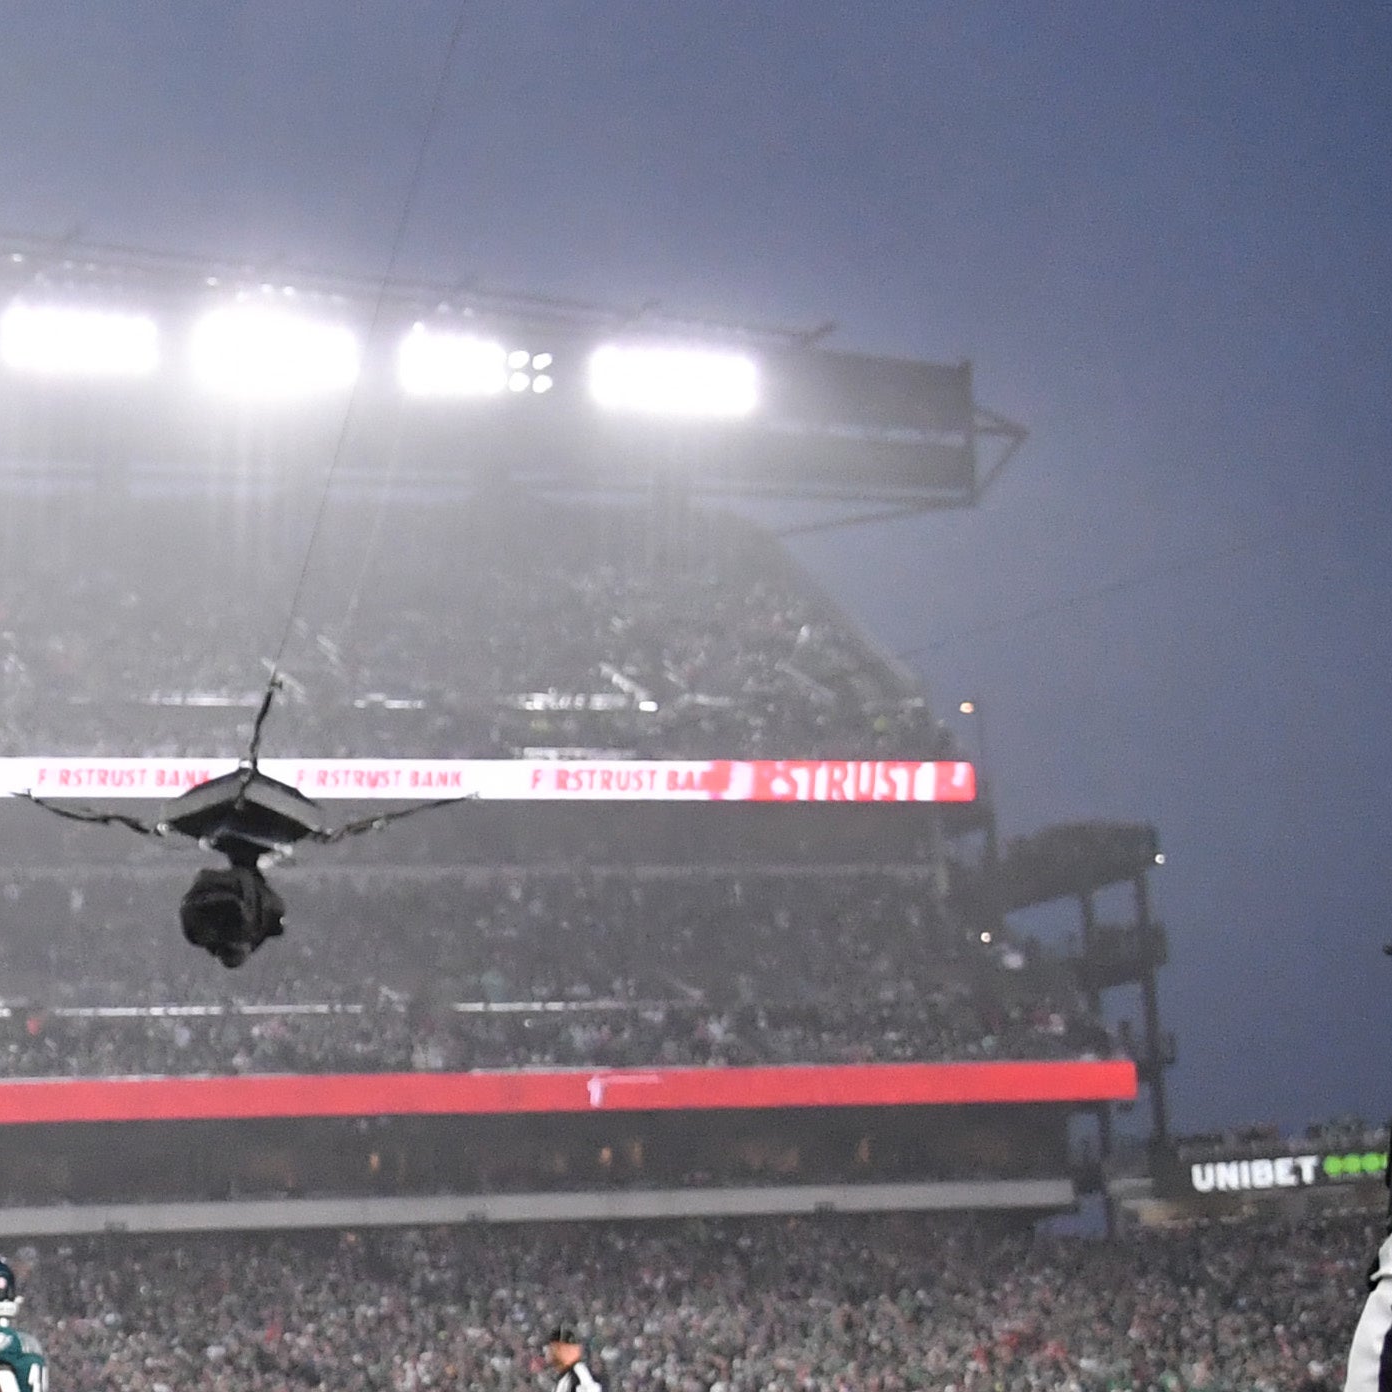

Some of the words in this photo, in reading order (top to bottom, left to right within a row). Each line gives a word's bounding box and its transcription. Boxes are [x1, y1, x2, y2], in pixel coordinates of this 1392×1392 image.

[38, 768, 147, 787] FRSTRUST
[155, 769, 211, 788] BANK
[409, 771, 462, 788] BANK
[531, 769, 657, 790] FRSTRUST
[1191, 1155, 1318, 1193] UNIBET
